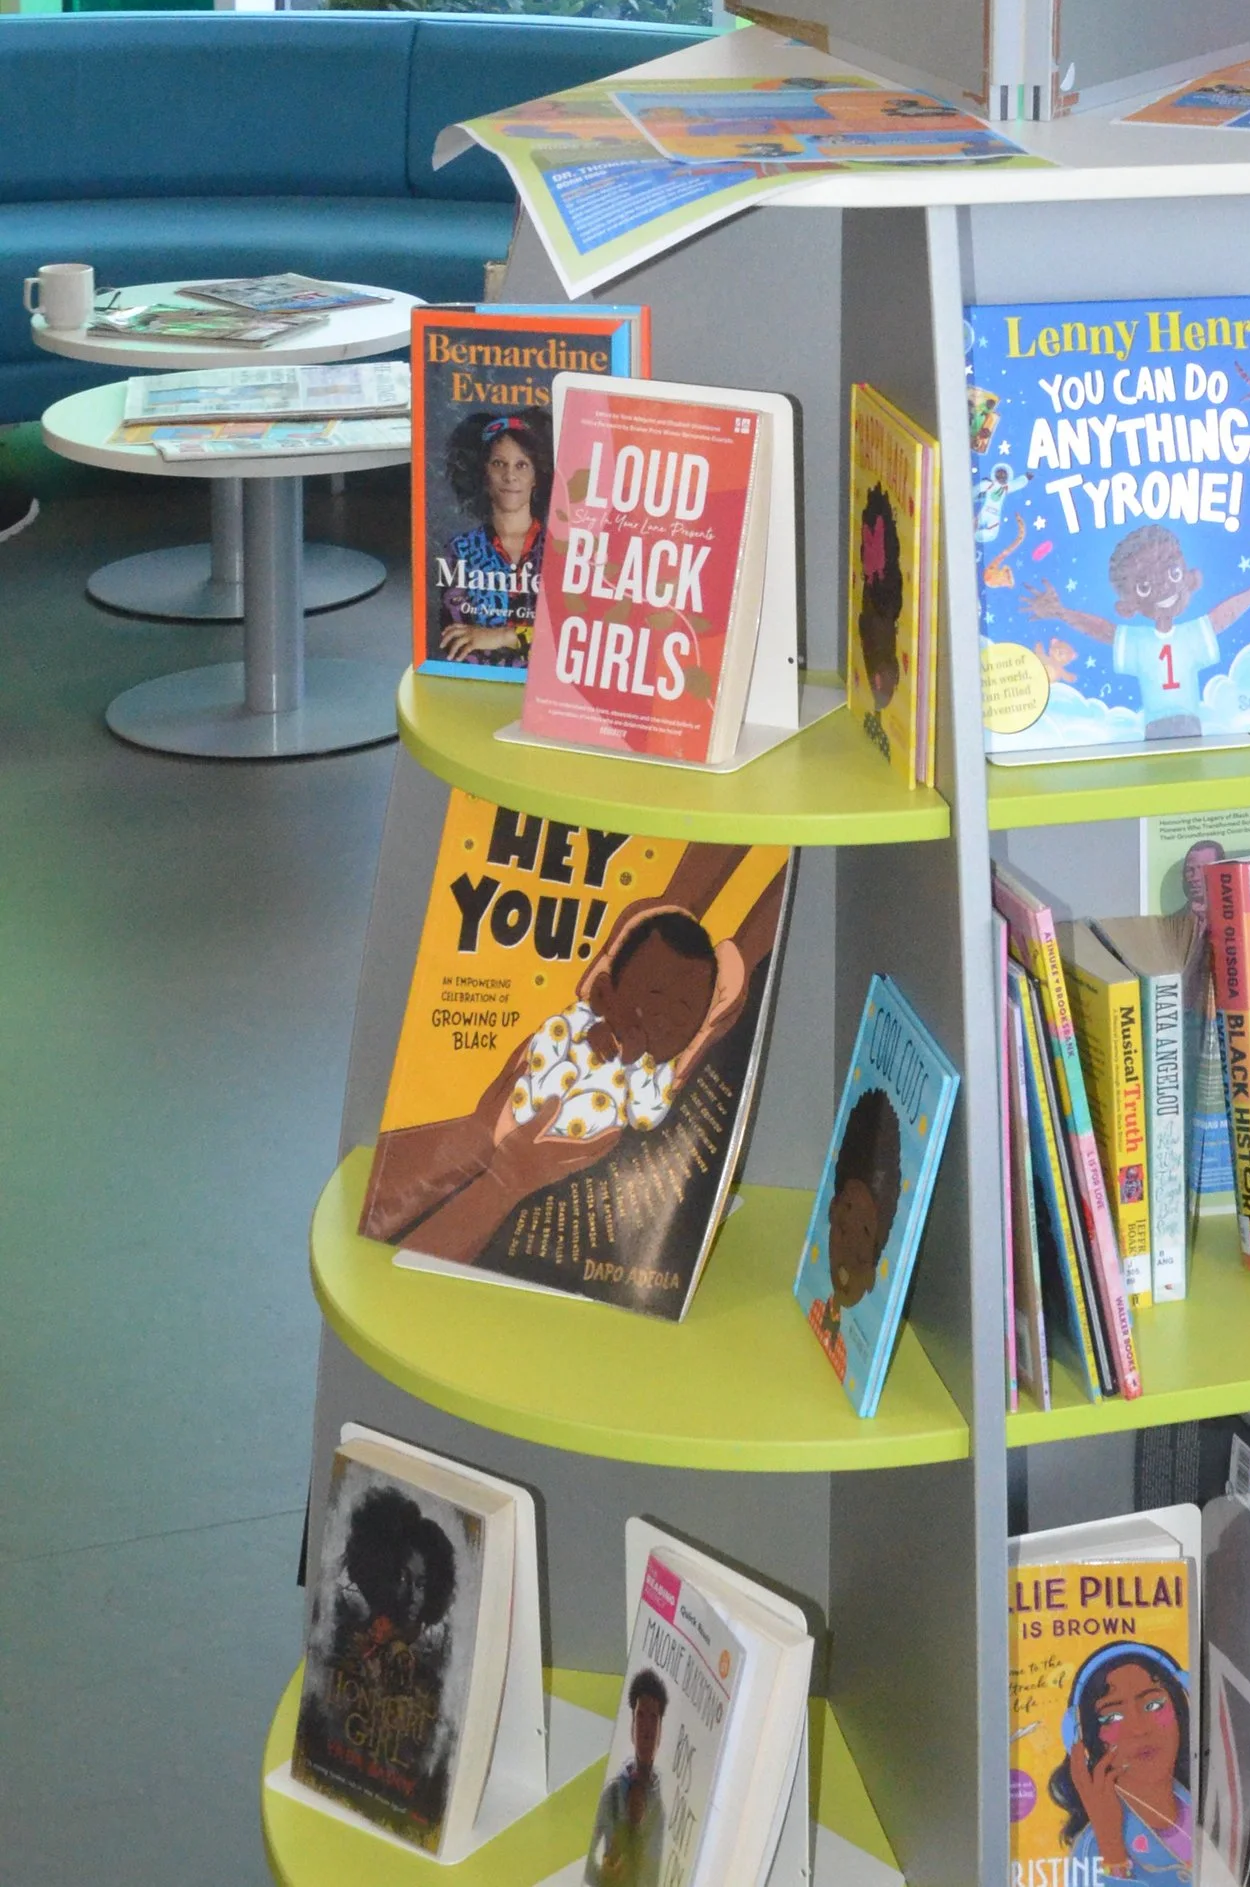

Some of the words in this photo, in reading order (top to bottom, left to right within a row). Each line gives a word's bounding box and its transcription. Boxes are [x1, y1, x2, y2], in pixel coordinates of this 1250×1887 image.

[427, 333, 608, 371] Bernardine
[1005, 315, 1141, 361] Lenny
[1038, 369, 1106, 414] YOU
[1112, 365, 1177, 406] CAN
[1183, 362, 1229, 403] DO
[584, 441, 710, 521] LOUD
[1044, 470, 1244, 535] TYRONE!
[572, 508, 597, 530] Slay
[615, 514, 638, 532] Your
[640, 518, 667, 535] Lane
[670, 520, 716, 541] Presents
[561, 530, 712, 613] BLACK
[460, 602, 477, 616] On
[479, 604, 515, 619] Never
[556, 615, 691, 701] GIRLS
[1157, 644, 1181, 691] 1
[487, 805, 632, 889] HEY
[449, 872, 609, 962] YOU!
[1219, 873, 1234, 922] DAVID
[442, 975, 453, 987] AN
[455, 975, 511, 990] EMPOWERING
[1224, 925, 1240, 1000] OLUSOGA
[431, 1007, 500, 1029] GROWING
[501, 1010, 521, 1028] UP
[440, 990, 496, 1004] CELEBRATION
[498, 993, 509, 1004] OF
[1042, 931, 1060, 978] ATINUKE
[1053, 985, 1076, 1060] BROOKSBANK
[1155, 983, 1179, 1034] MAYA
[452, 1030, 497, 1052] BLACK
[868, 1007, 902, 1083] COOL
[896, 1038, 930, 1126] CUTS
[1119, 1005, 1139, 1083] Musical
[1226, 1014, 1250, 1099] BLACK
[1155, 1037, 1180, 1117] ANGELOU
[1122, 1083, 1141, 1153] Truth
[583, 1258, 623, 1284] DAPO
[623, 1262, 680, 1290] ADEOLA
[1156, 1257, 1174, 1266] ANG
[1114, 1296, 1130, 1342] WALKER
[1123, 1343, 1137, 1373] BOOKS
[643, 1573, 676, 1606] READING
[1079, 1575, 1184, 1609] PILLAI
[642, 1617, 687, 1687] MALORIE
[1022, 1619, 1043, 1639] IS
[1052, 1617, 1136, 1638] BROWN
